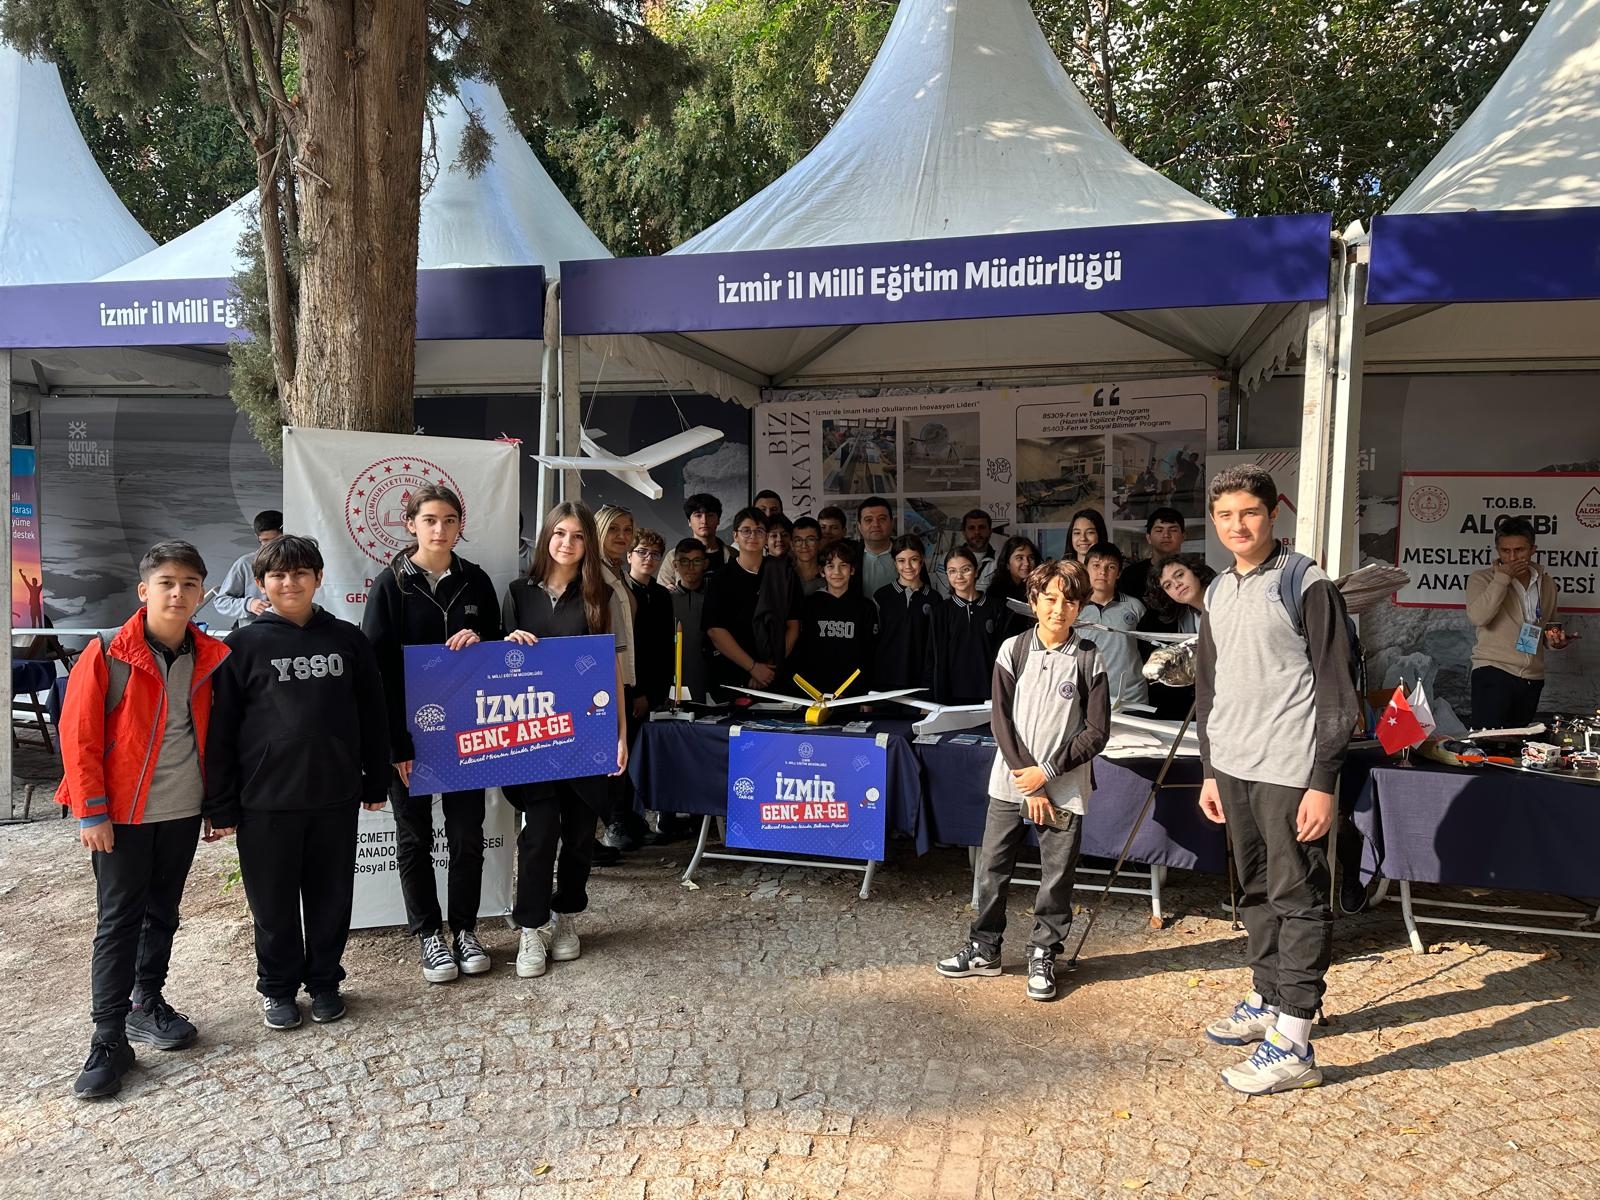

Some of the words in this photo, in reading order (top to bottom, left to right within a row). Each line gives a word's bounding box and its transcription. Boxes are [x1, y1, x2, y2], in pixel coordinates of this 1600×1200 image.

[787, 270, 803, 299] il
[809, 266, 864, 298] Milli
[870, 261, 958, 302] Eğitim
[964, 250, 1122, 290] Müdürlüğü
[152, 300, 163, 324] il
[167, 298, 208, 324] Milli
[213, 297, 242, 328] Eğ
[762, 412, 788, 456] BİZ
[68, 441, 98, 453] KUTUP
[68, 450, 110, 468] ŞENLİĞİ
[1482, 497, 1536, 509] T.O.B.B.
[1402, 546, 1492, 565] MESLEKİ
[817, 620, 855, 639] YSSO
[270, 653, 344, 682] YSSO
[475, 685, 556, 725] İZMİR
[459, 726, 509, 754] GENÇ
[517, 714, 571, 743] AR-GE
[775, 771, 836, 803] İZMİR
[762, 804, 800, 822] GENÇ
[804, 803, 847, 820] AR-GE
[353, 860, 386, 875] Sosyal
